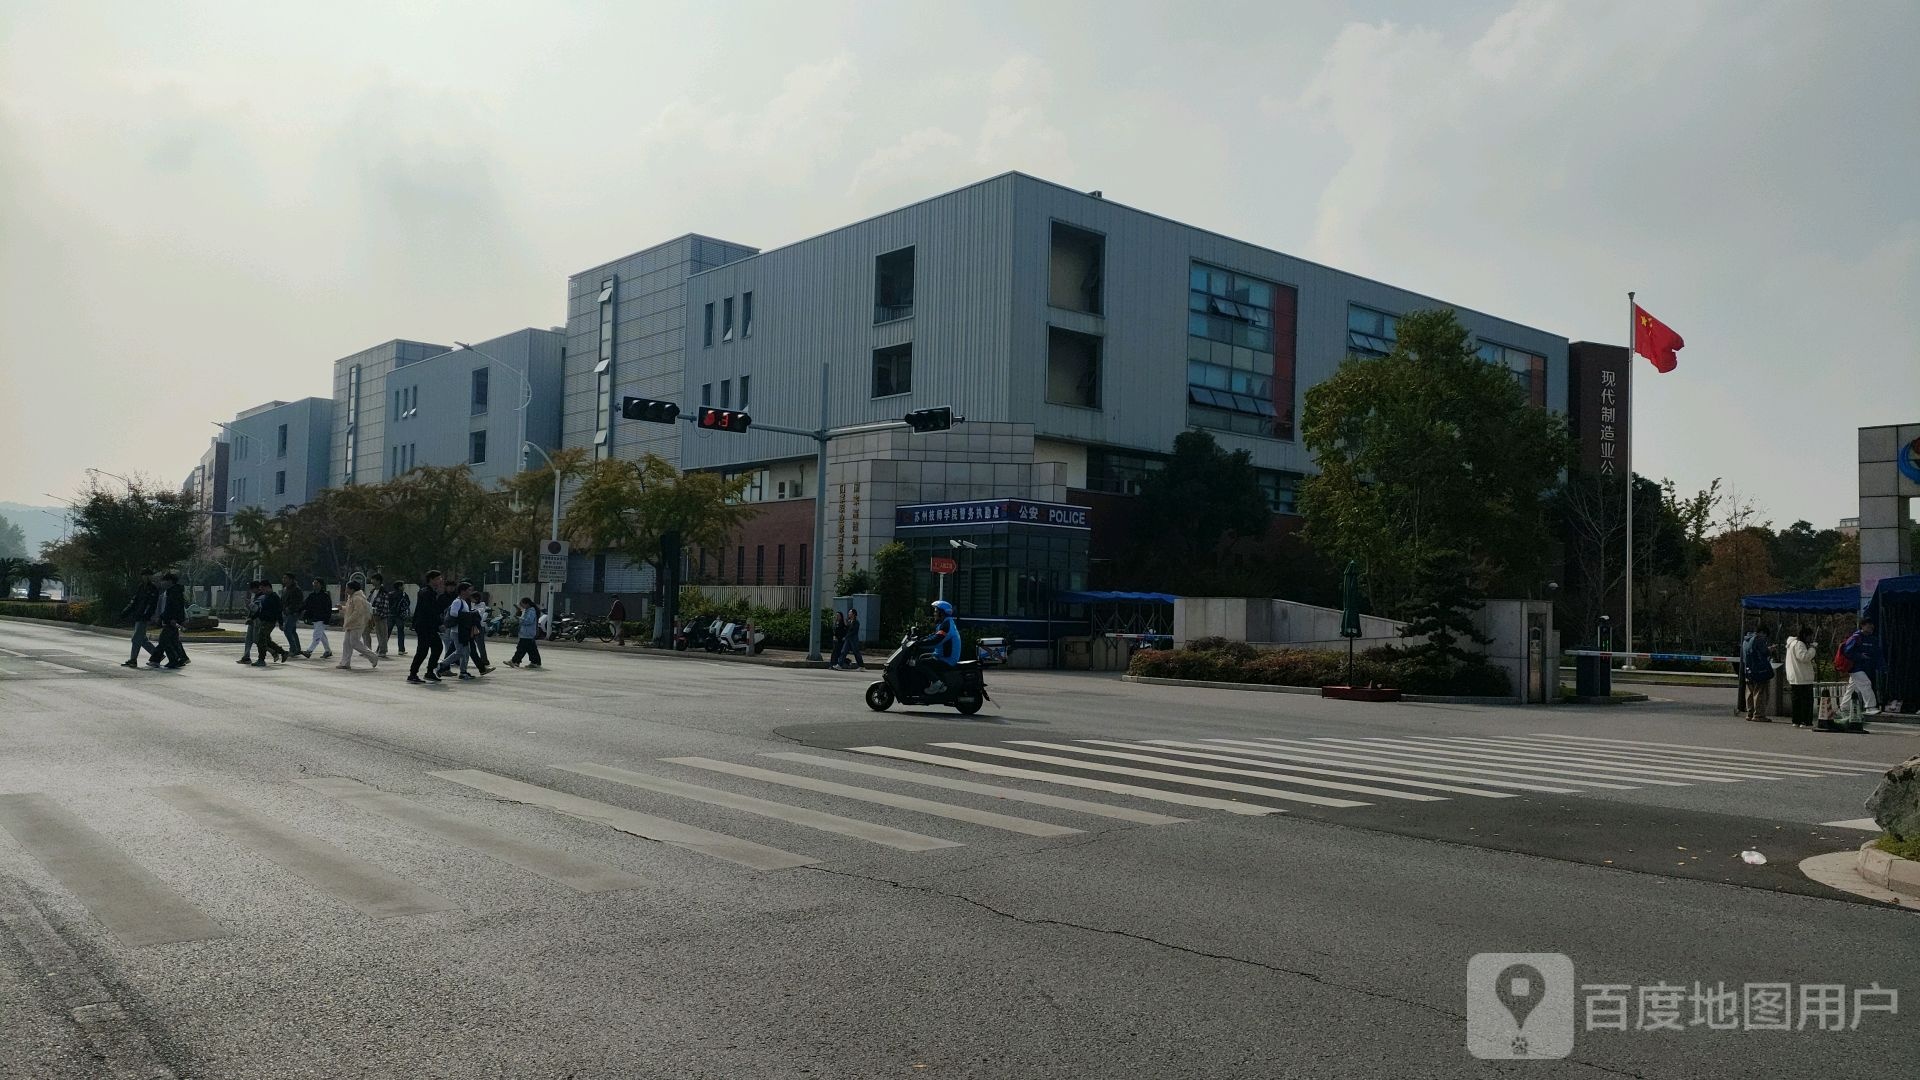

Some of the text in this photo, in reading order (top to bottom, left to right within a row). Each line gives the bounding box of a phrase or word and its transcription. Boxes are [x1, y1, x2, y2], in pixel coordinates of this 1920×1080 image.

[914, 505, 999, 523] 苏州技师学院警务执勤点
[1019, 505, 1086, 525] 公安 POLICE
